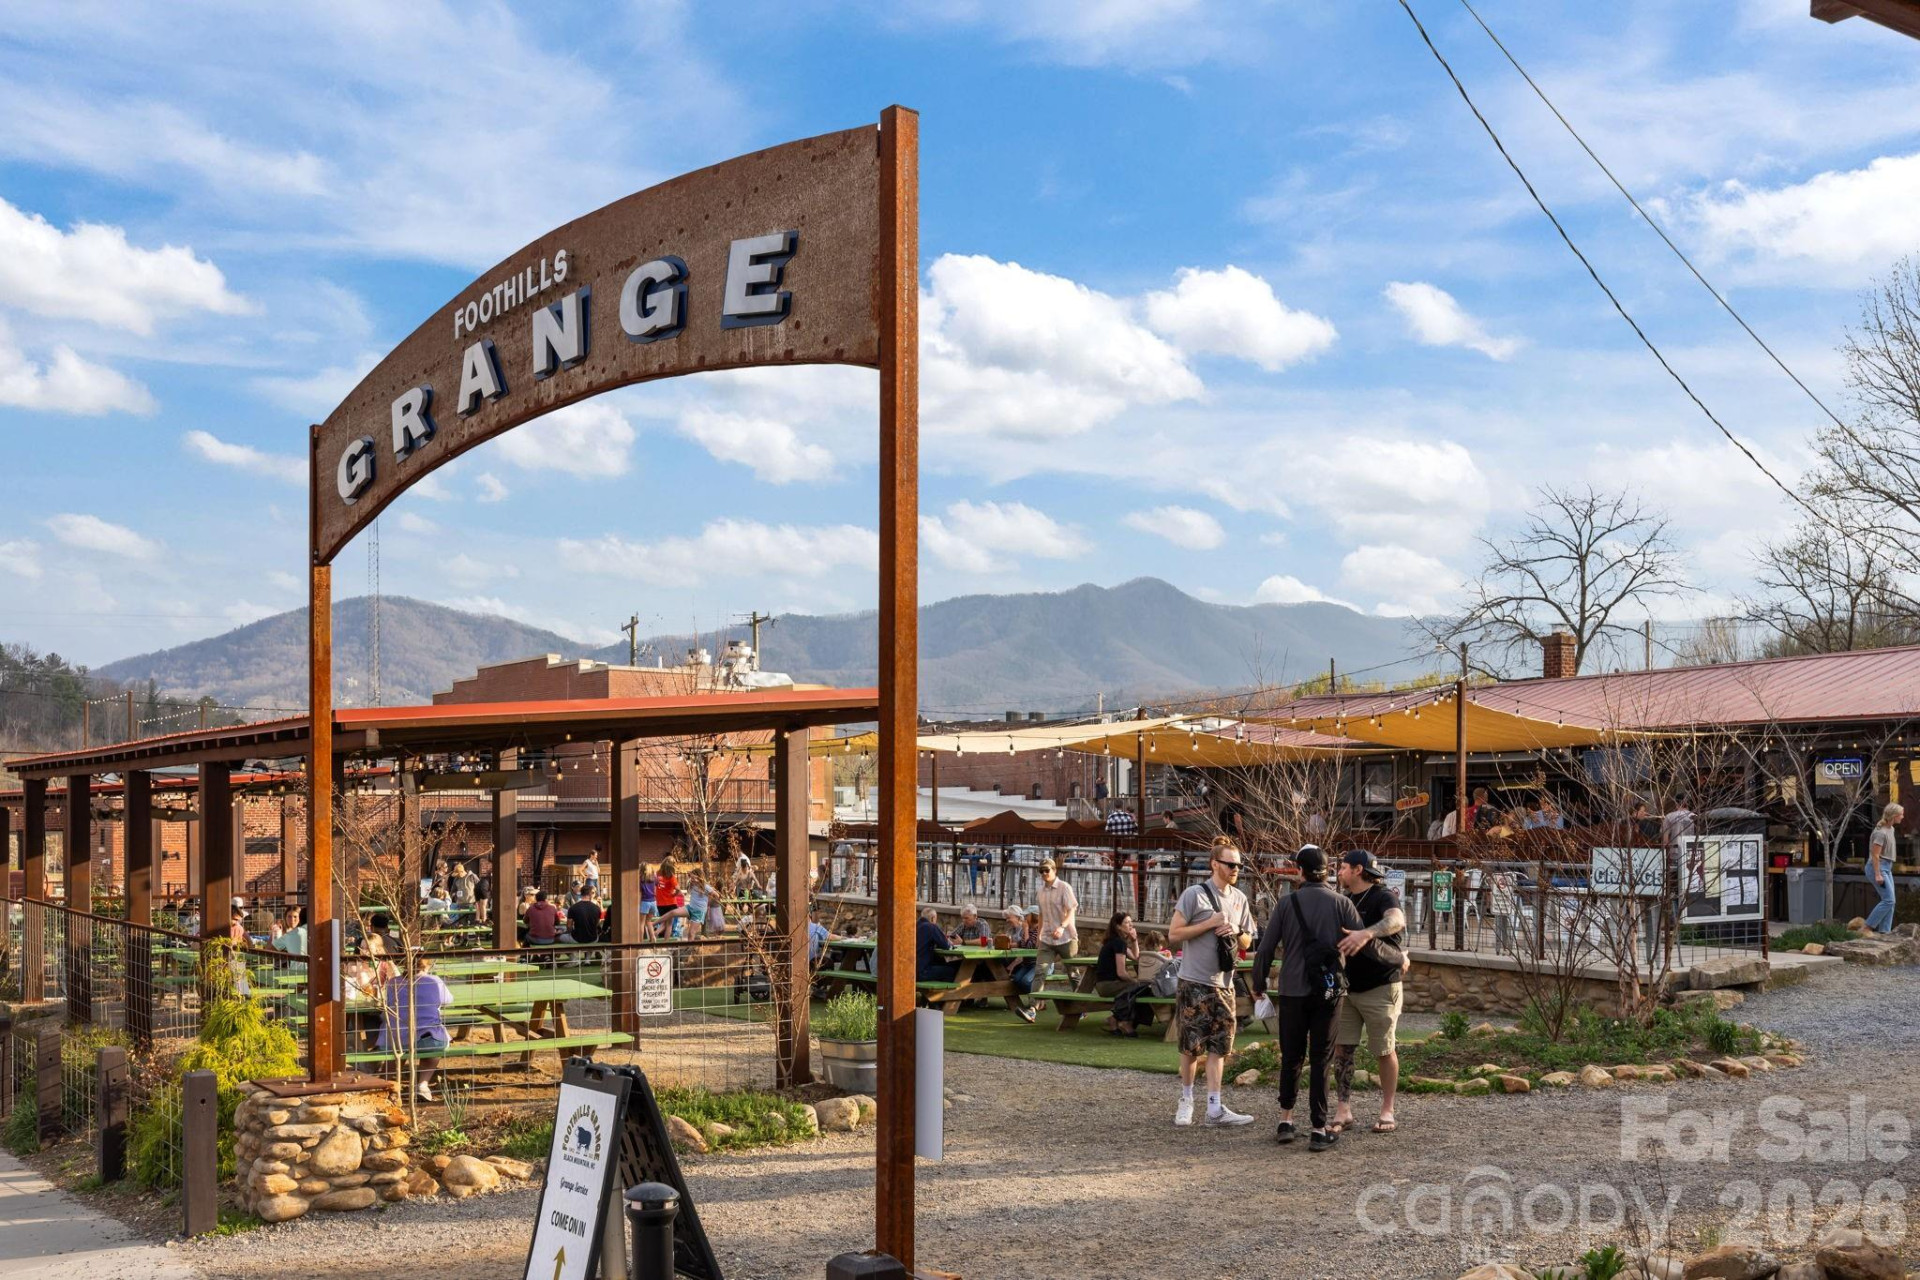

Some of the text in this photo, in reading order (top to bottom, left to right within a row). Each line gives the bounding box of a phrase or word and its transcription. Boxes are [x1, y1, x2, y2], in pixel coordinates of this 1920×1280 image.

[454, 249, 568, 339] FOOTHILLS
[337, 231, 797, 504] GRANGE
[1825, 762, 1859, 775] OPEN
[562, 1104, 601, 1161] FOOTHILLS GRANGE
[563, 1153, 574, 1162] BLACK
[551, 1210, 587, 1238] COME ON IN
